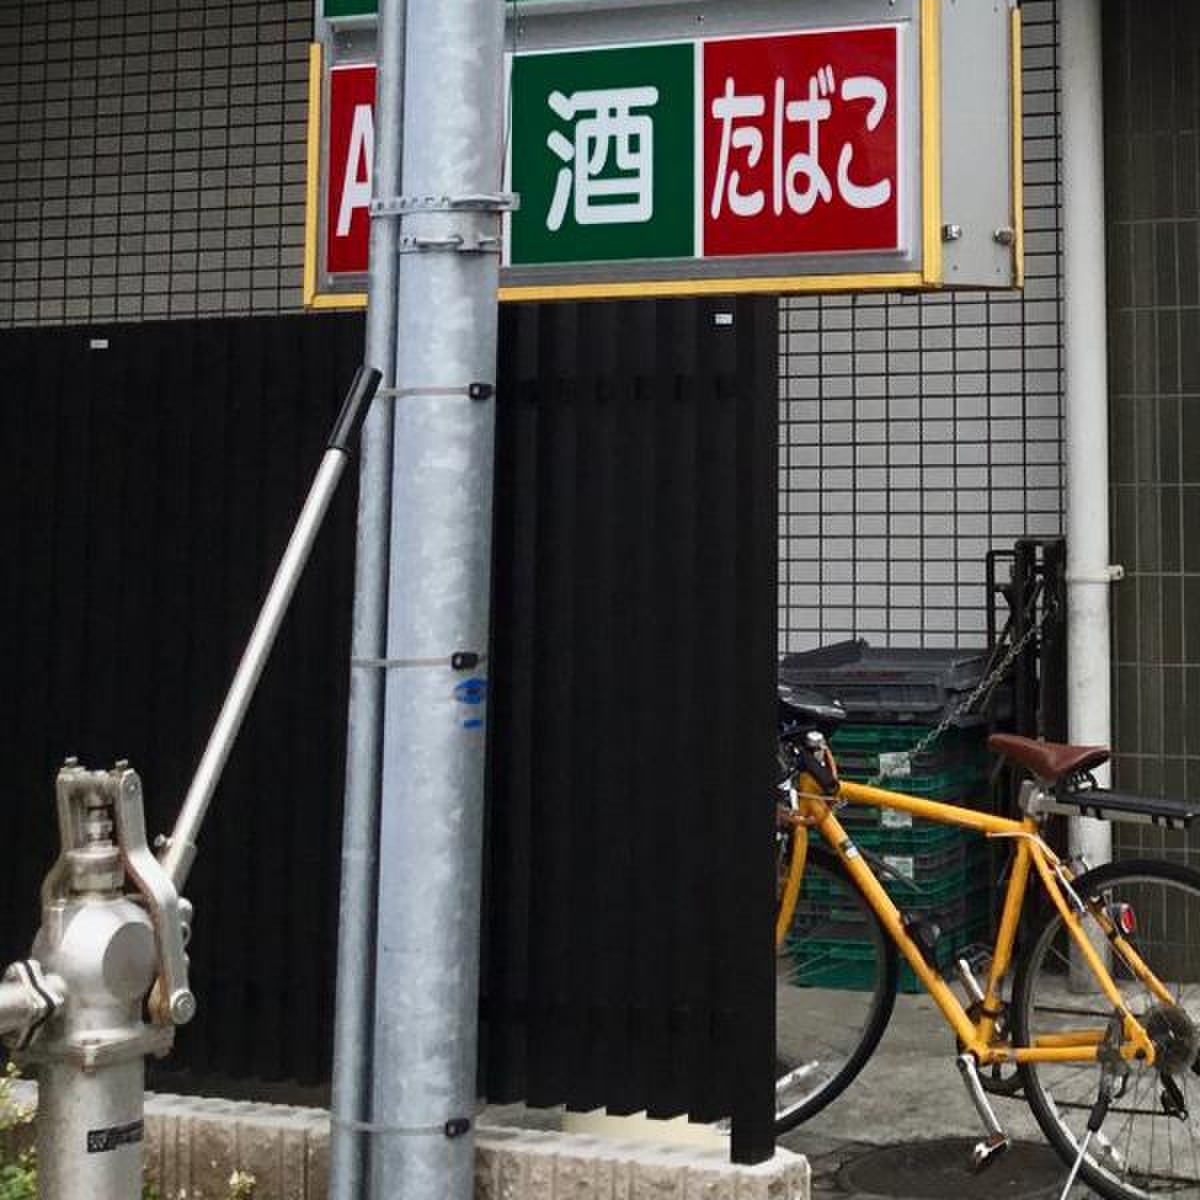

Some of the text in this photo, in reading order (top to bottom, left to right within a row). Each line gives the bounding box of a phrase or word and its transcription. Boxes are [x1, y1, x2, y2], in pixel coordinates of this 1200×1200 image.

[545, 85, 659, 231] 酒
[710, 64, 892, 220] たばこ
